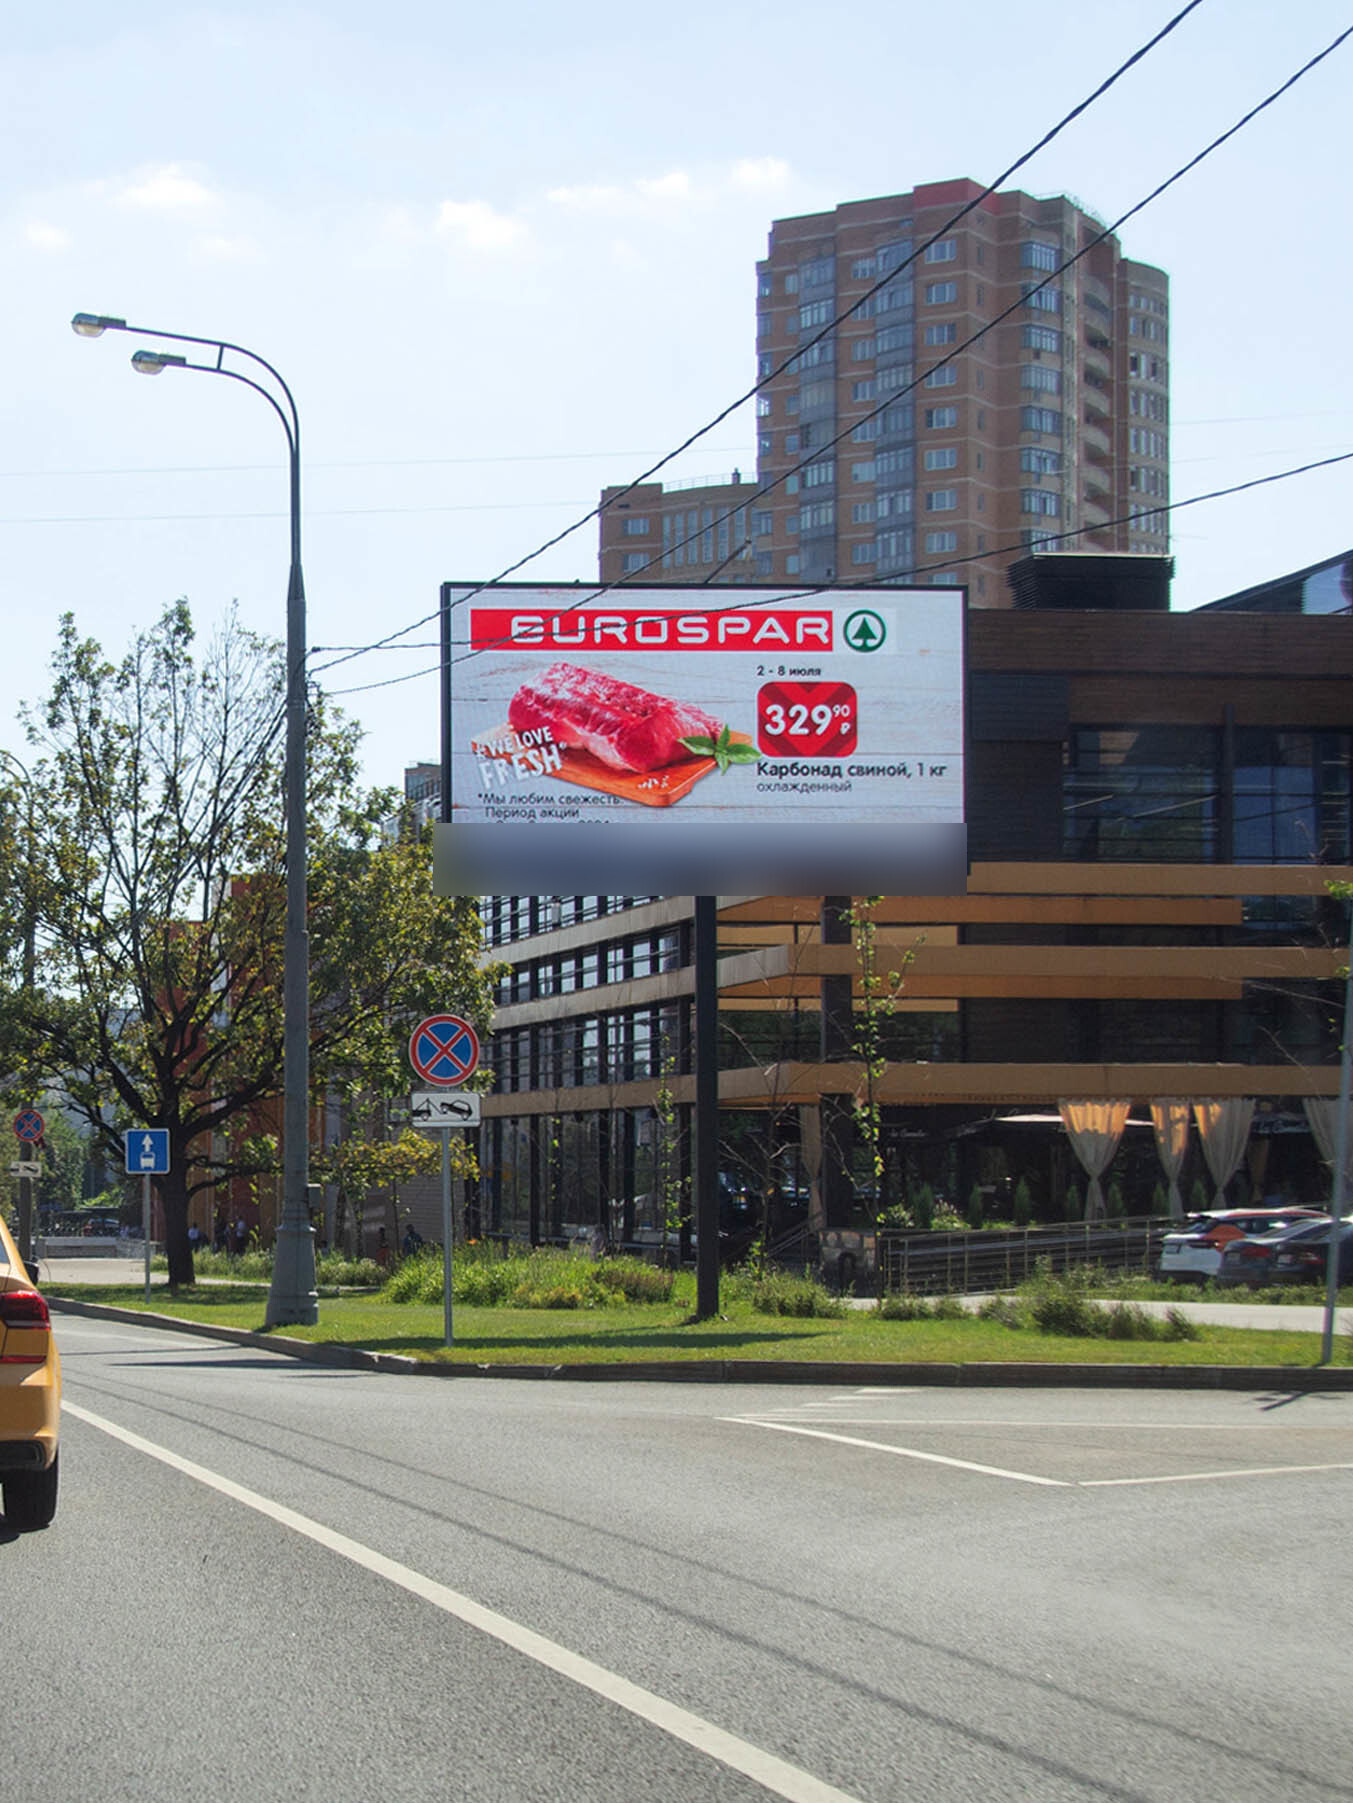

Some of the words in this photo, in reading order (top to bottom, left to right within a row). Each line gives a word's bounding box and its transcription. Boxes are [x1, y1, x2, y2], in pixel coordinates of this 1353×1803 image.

[511, 615, 830, 645] EUROSPAR
[756, 665, 765, 677] 2
[777, 665, 786, 677] 8
[788, 667, 822, 677] июля
[764, 704, 833, 736] 329
[833, 704, 851, 718] 90
[514, 726, 554, 751] LOVE
[756, 762, 843, 779] Карбонад
[847, 762, 912, 778] свиной,
[917, 762, 924, 776] 1
[929, 764, 948, 777] кг
[756, 780, 852, 793] охлажденный
[508, 792, 555, 805] любим
[485, 806, 536, 818] Период
[539, 808, 580, 819] акции
